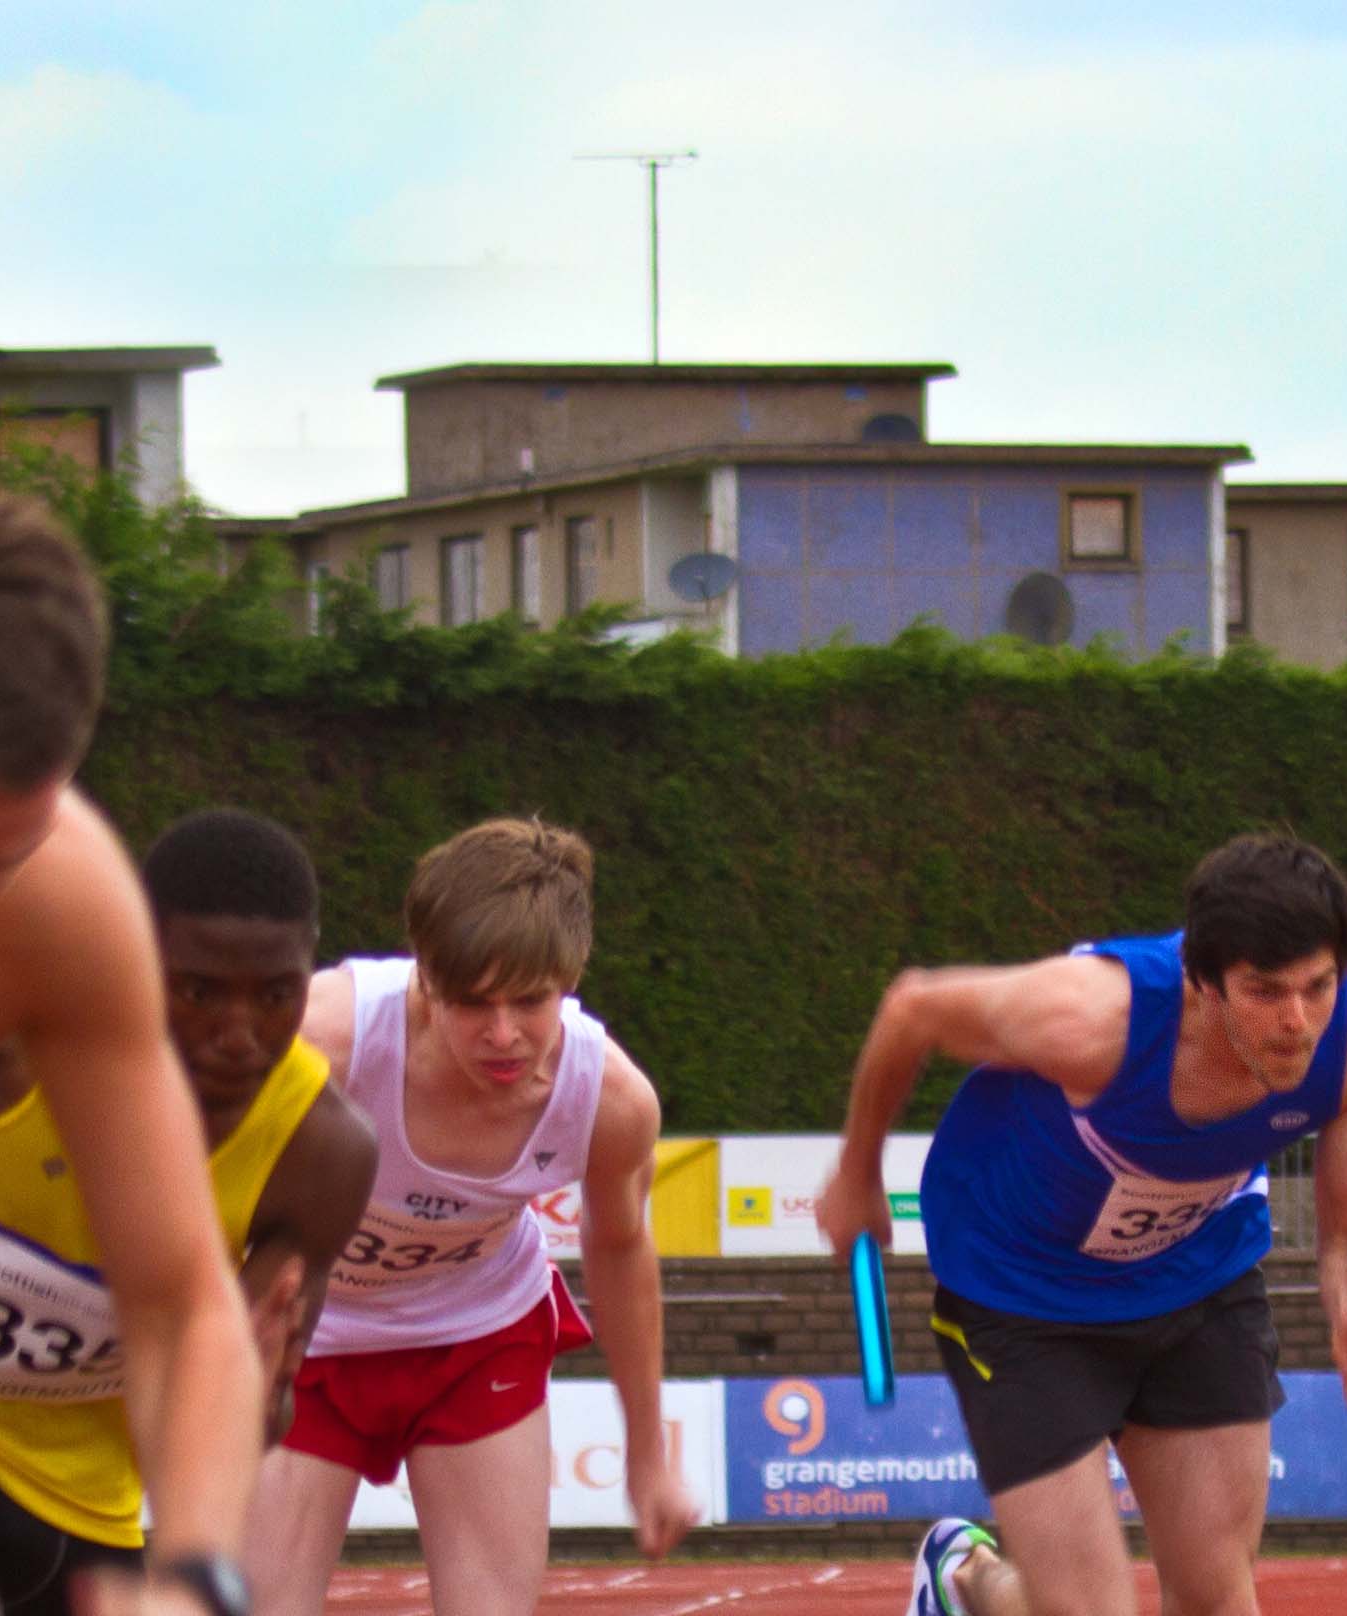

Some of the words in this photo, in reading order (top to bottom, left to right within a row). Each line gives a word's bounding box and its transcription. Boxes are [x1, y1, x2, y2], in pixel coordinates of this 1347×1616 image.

[406, 1193, 468, 1213] CITY
[341, 1229, 485, 1272] 334
[764, 1453, 978, 1490] grangemouth
[764, 1487, 889, 1516] stadium
